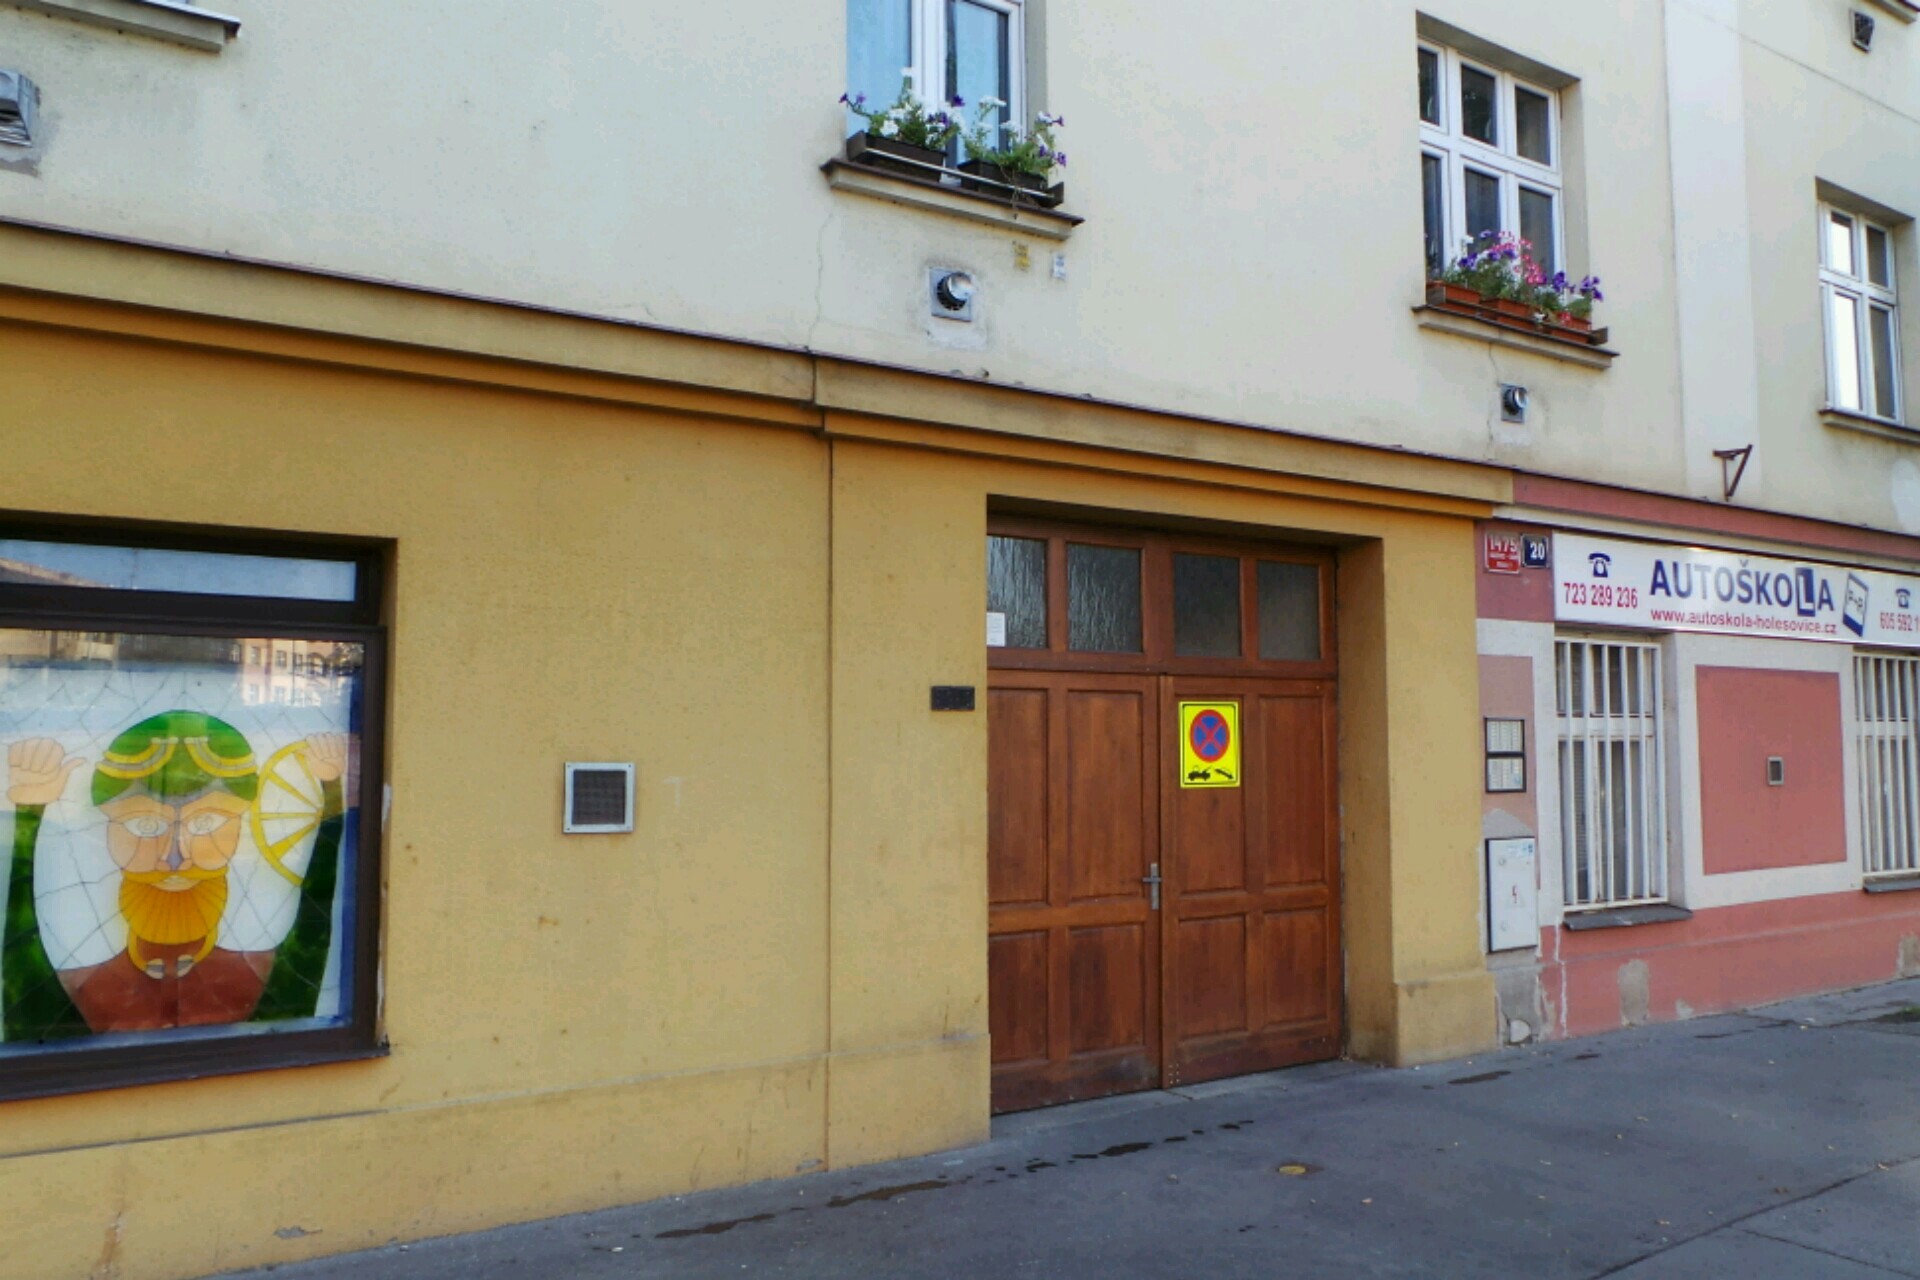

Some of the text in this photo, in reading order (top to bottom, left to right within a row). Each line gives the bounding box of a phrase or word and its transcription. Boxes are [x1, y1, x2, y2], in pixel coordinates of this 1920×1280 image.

[1529, 540, 1546, 560] 20
[1563, 582, 1639, 609] 723 289 236
[1649, 559, 1835, 613] AUTOŠKOLA
[1650, 609, 1838, 635] www.autoskola-holesovice.cz
